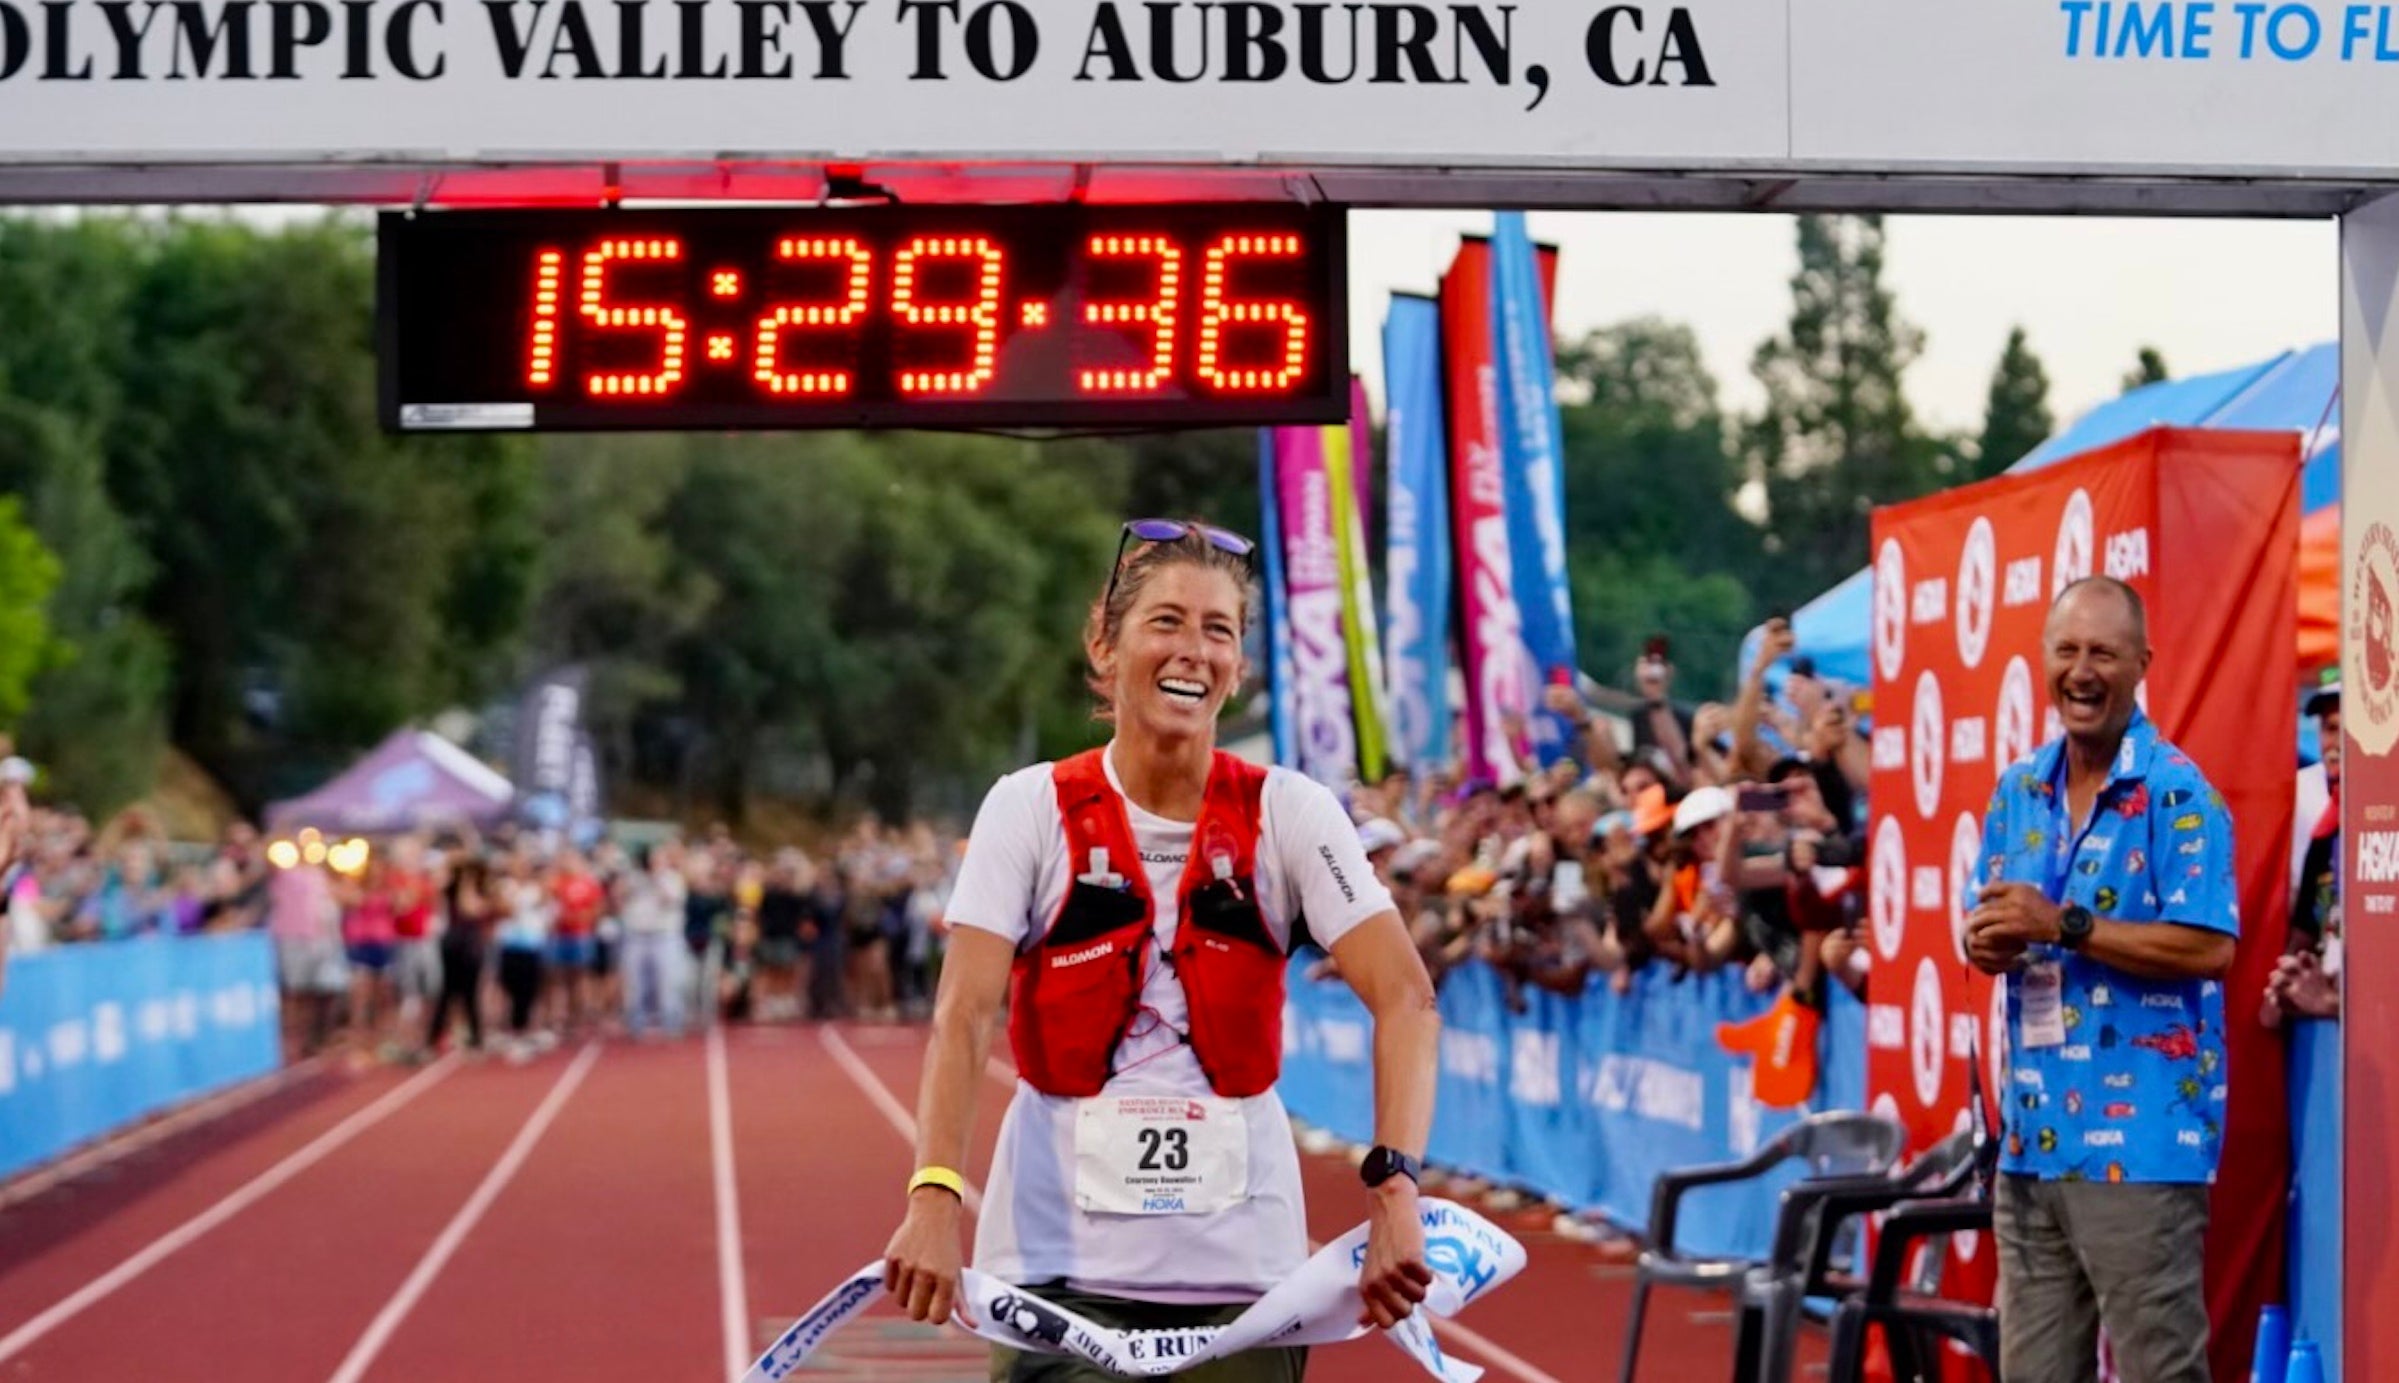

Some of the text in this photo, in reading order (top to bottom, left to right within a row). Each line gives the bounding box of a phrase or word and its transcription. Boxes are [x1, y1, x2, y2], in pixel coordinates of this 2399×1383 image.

[2060, 0, 2214, 59] TIME
[2234, 3, 2322, 61] TO
[483, 0, 868, 80] VALLEY
[896, 0, 1040, 81] TO
[1074, 1, 1550, 112] AUBURN,
[1585, 5, 1717, 87] CA
[1139, 851, 1189, 864] ALOMO
[1318, 845, 1356, 904] SALOMON
[1051, 942, 1114, 968] SALOMON
[1138, 1127, 1189, 1171] 23
[1143, 1199, 1184, 1210] HOKA
